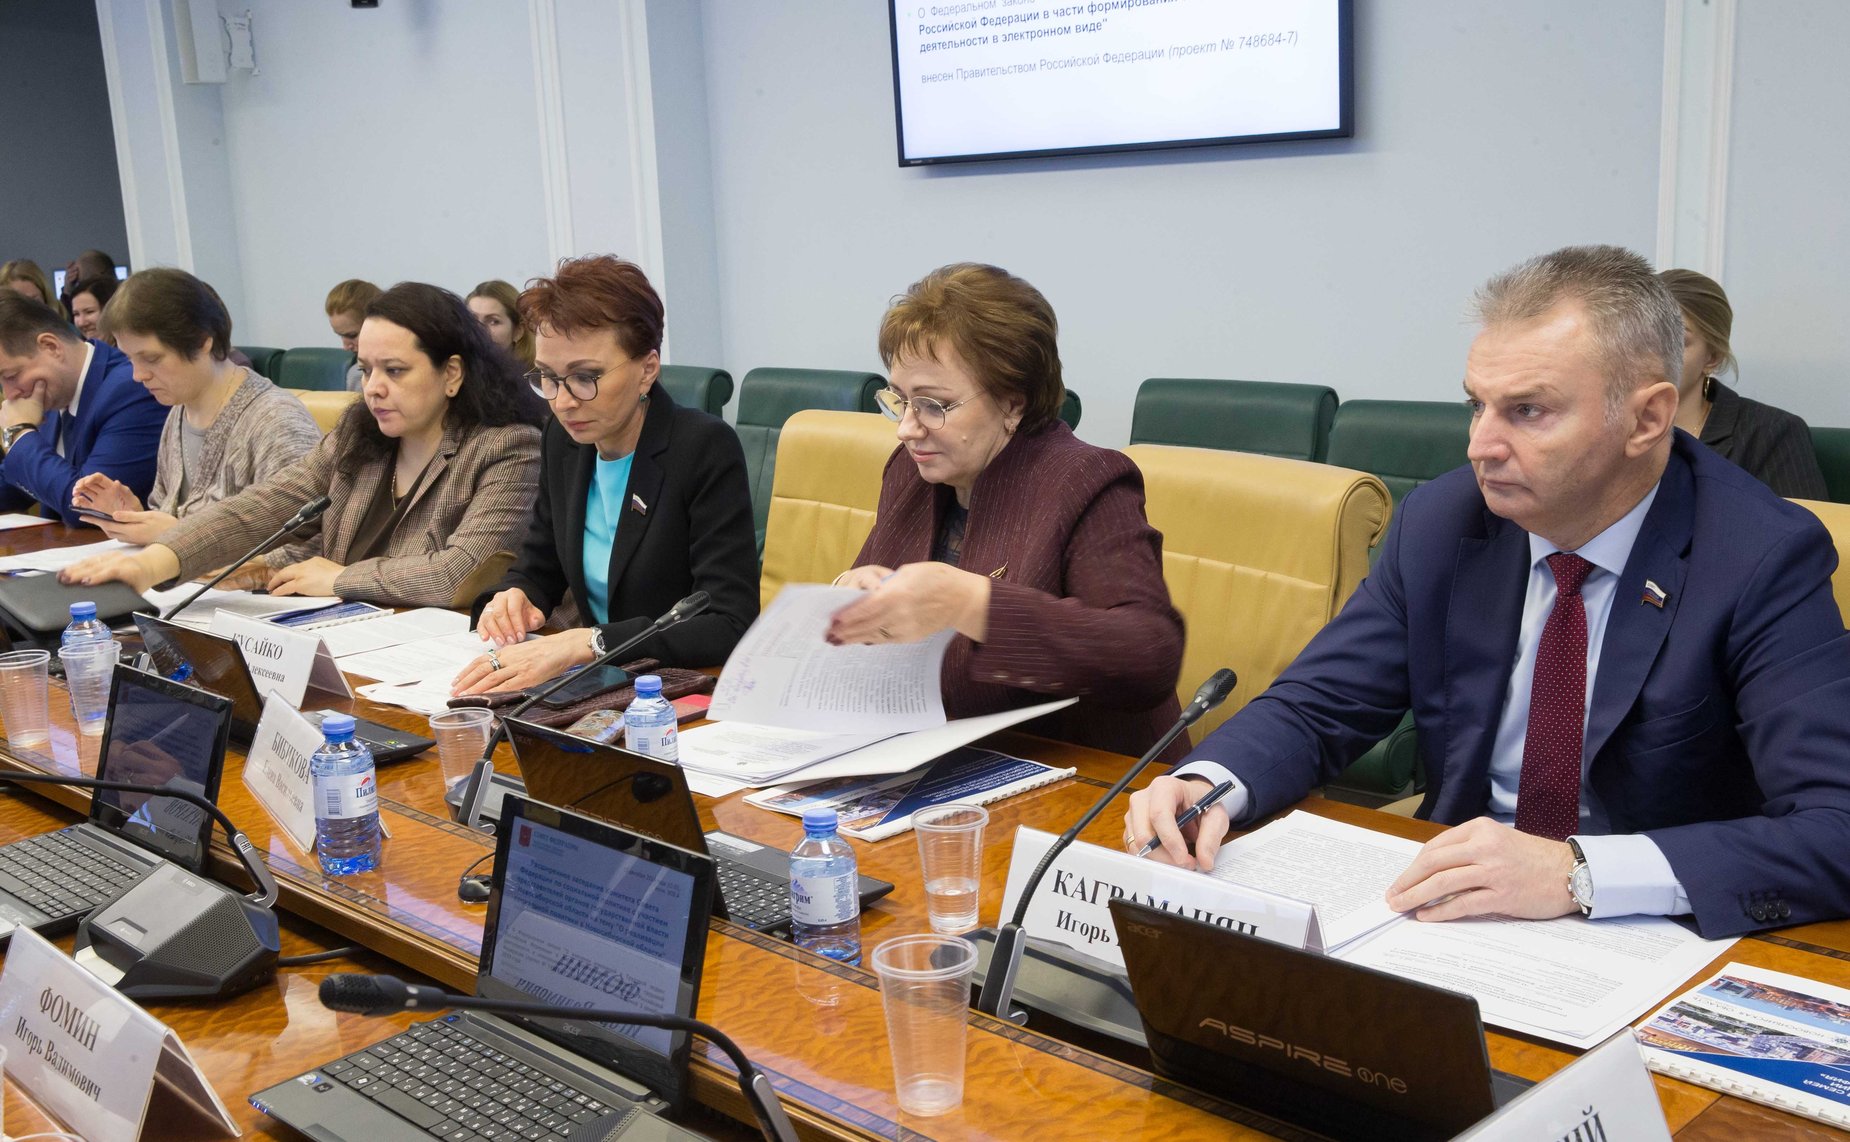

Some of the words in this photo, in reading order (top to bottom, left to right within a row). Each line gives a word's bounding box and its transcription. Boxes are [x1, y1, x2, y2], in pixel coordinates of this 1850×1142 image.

[918, 8, 925, 19] О
[930, 0, 997, 16] Федеральном
[919, 19, 977, 35] Российской
[980, 12, 1040, 29] Федерации
[1043, 11, 1050, 20] в
[1052, 6, 1084, 18] части
[919, 36, 989, 54] деятельности
[992, 34, 999, 44] в
[1001, 25, 1071, 44] электронном
[921, 72, 954, 84] внесен
[956, 62, 1037, 81] Правительством
[1039, 54, 1100, 71] Российской
[1102, 49, 1165, 64] Федерации
[1168, 40, 1217, 60] (проект
[1220, 38, 1235, 51] №
[1239, 30, 1299, 48] 748684-7)
[271, 732, 312, 785] БИБИКОВА
[1056, 909, 1110, 944] Игорь
[15, 1015, 42, 1055] Игорь
[40, 986, 101, 1054] ФОМИН
[562, 1022, 581, 1036] acer
[1199, 1017, 1352, 1077] ASPIRE
[1802, 1079, 1845, 1095] СЕМЕЙ
